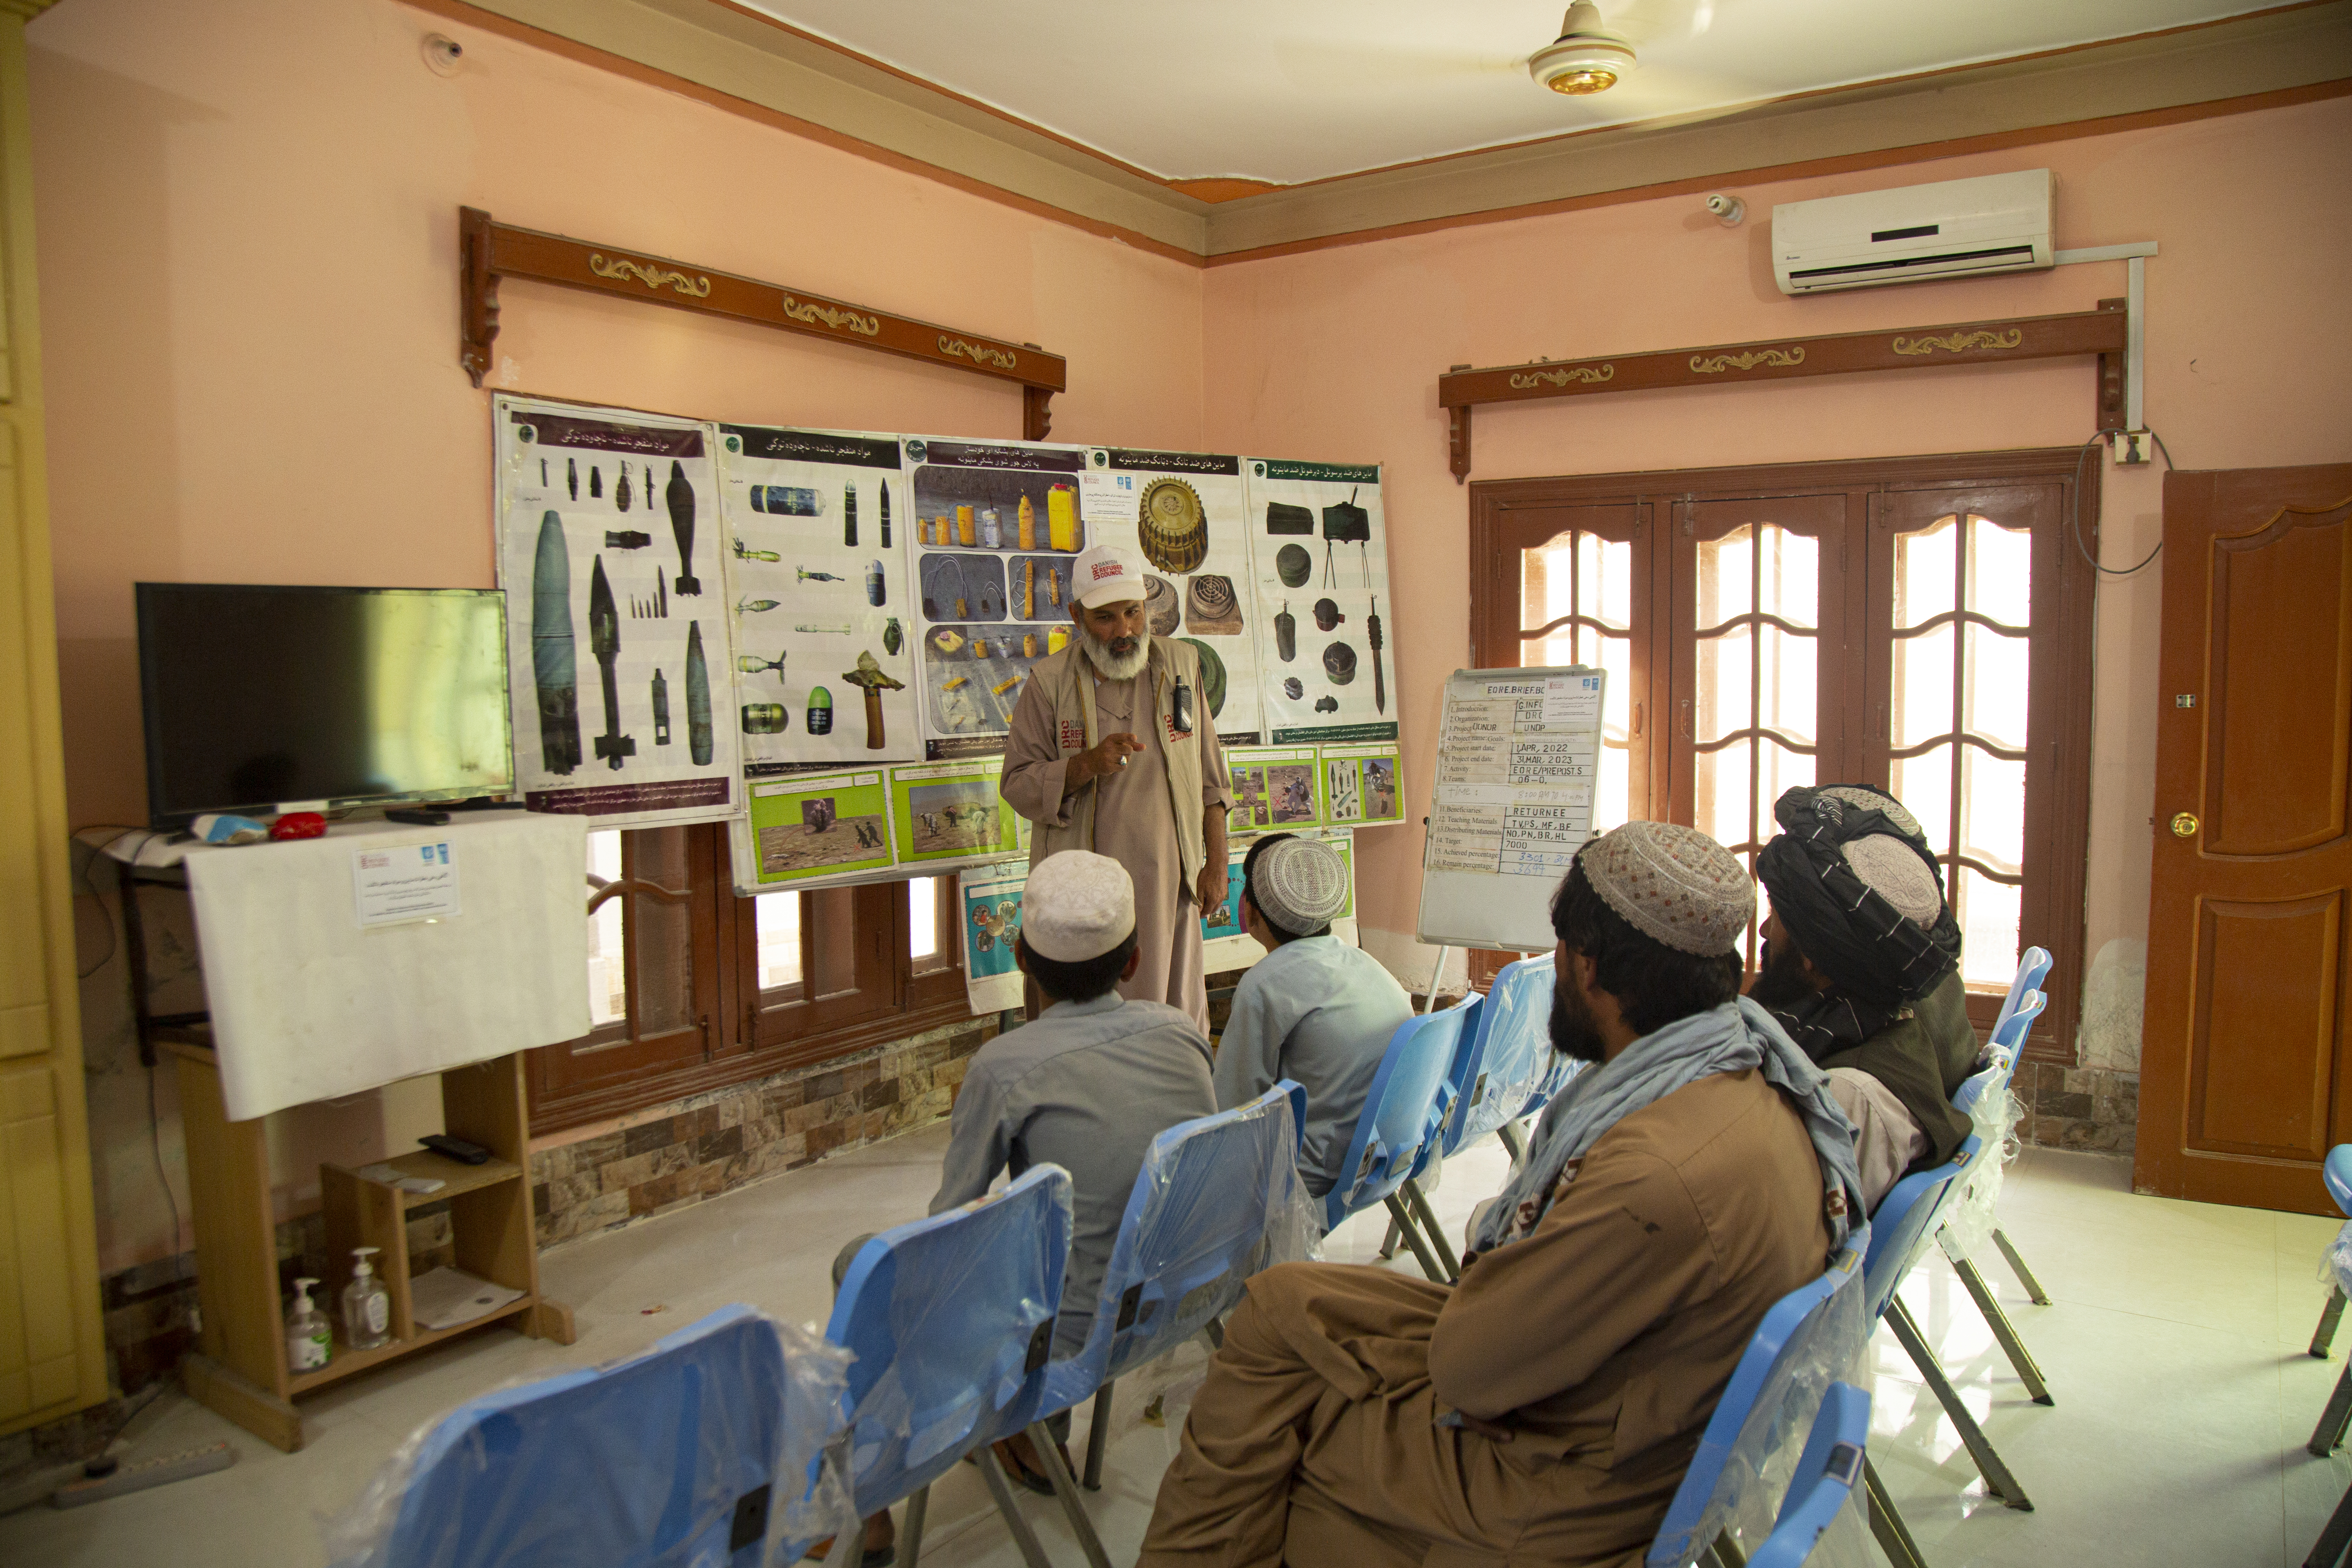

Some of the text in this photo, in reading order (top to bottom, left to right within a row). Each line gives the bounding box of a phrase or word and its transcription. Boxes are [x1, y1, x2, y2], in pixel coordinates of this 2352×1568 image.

[1212, 460, 1225, 470] ماین
[1091, 564, 1101, 581] DRC
[1164, 714, 1176, 743] DRC
[1061, 720, 1070, 748] DRC
[1543, 744, 1568, 752] 2022
[1548, 756, 1572, 764] 2023
[1514, 808, 1566, 817] RETURNEE
[1448, 816, 1470, 824] Teaching
[1506, 840, 1527, 849] 7000
